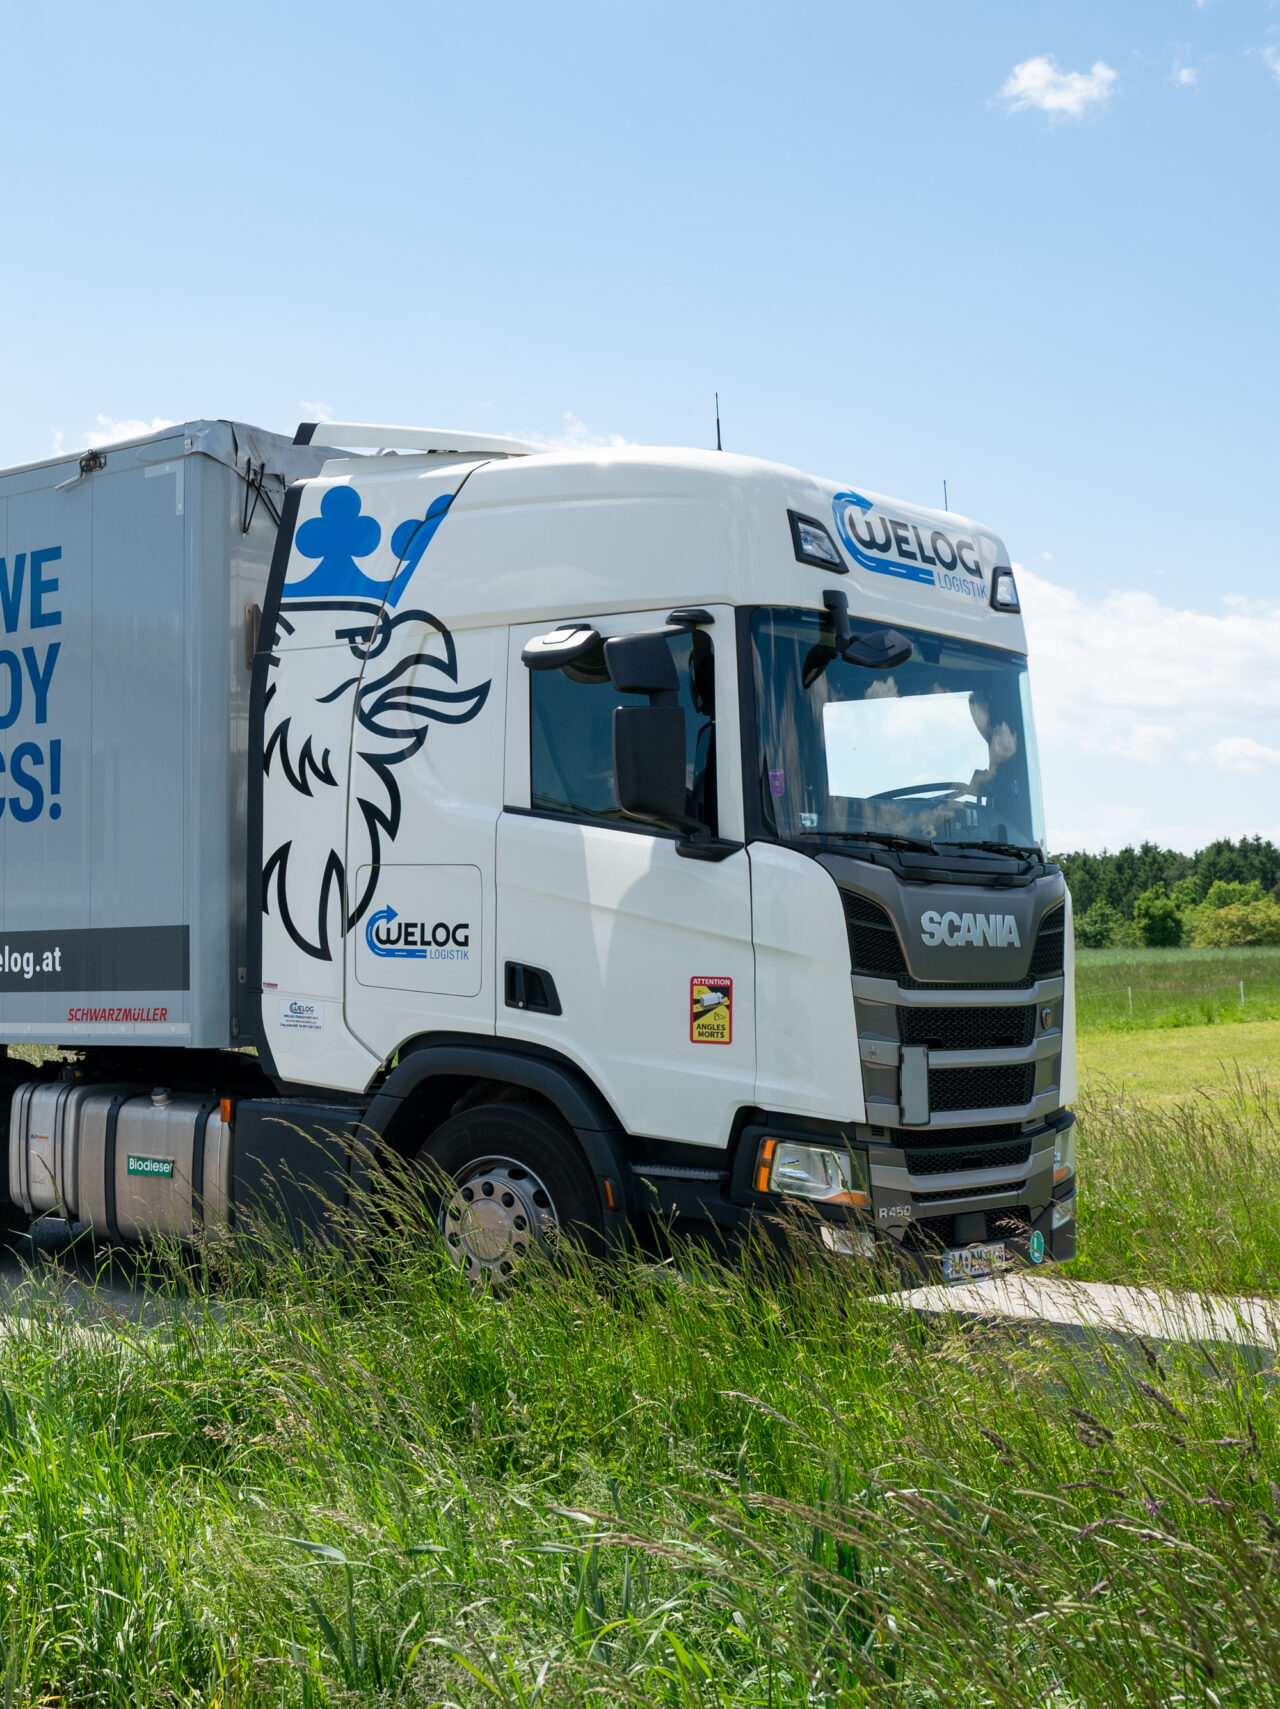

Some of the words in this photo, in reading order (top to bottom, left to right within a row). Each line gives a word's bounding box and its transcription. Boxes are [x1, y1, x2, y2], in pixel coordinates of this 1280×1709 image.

[848, 511, 984, 580] WELOG
[937, 572, 989, 600] LOGISTIK
[375, 922, 470, 948] WELOG
[920, 910, 1022, 948] SCANIA
[429, 949, 470, 961] LOGISTIK
[696, 1023, 726, 1031] ANGLES
